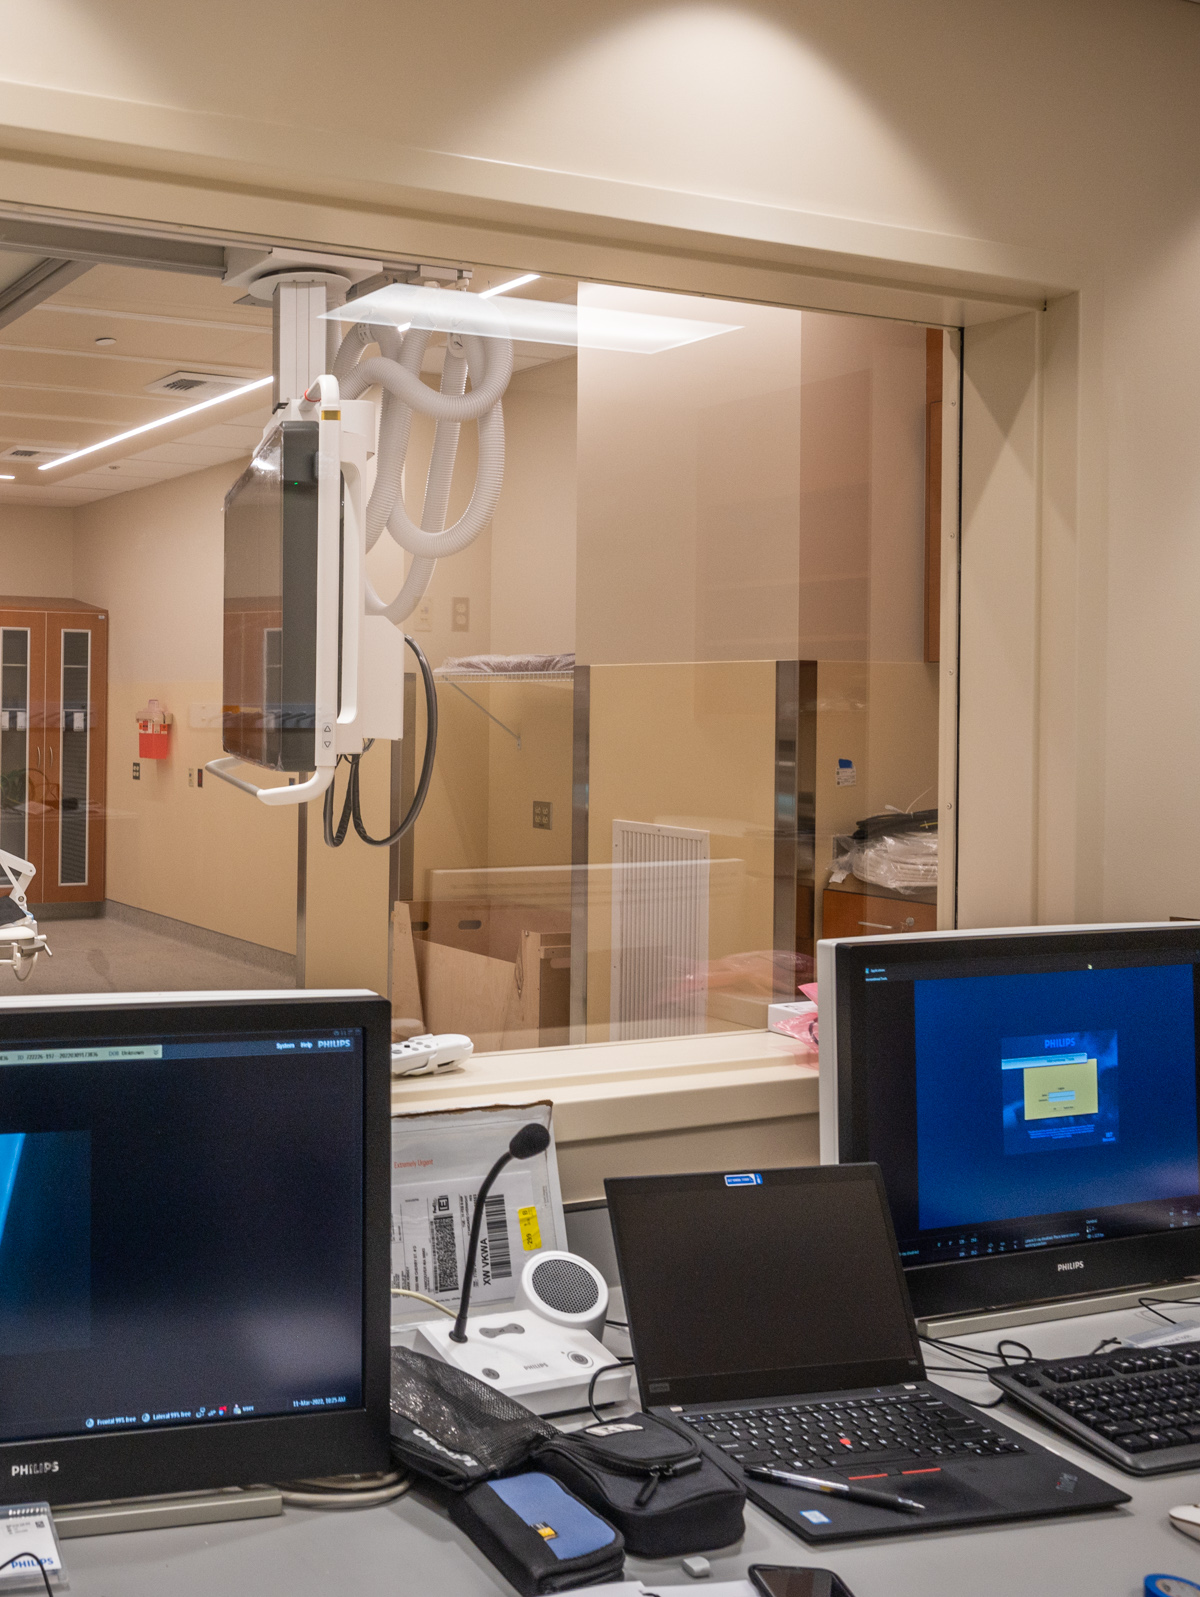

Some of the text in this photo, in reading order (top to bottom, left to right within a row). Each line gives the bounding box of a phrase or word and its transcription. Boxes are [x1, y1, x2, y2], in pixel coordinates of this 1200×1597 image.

[276, 1042, 295, 1050] System
[318, 1039, 350, 1048] PHILIPS
[1044, 1038, 1076, 1048] PHILIPS
[394, 1158, 434, 1169] Extremely Urgent
[480, 1238, 491, 1286] XW VKWA
[1057, 1261, 1084, 1272] PHILIPS
[523, 1362, 549, 1371] PHILIPS
[12, 1461, 59, 1476] PHILIPS
